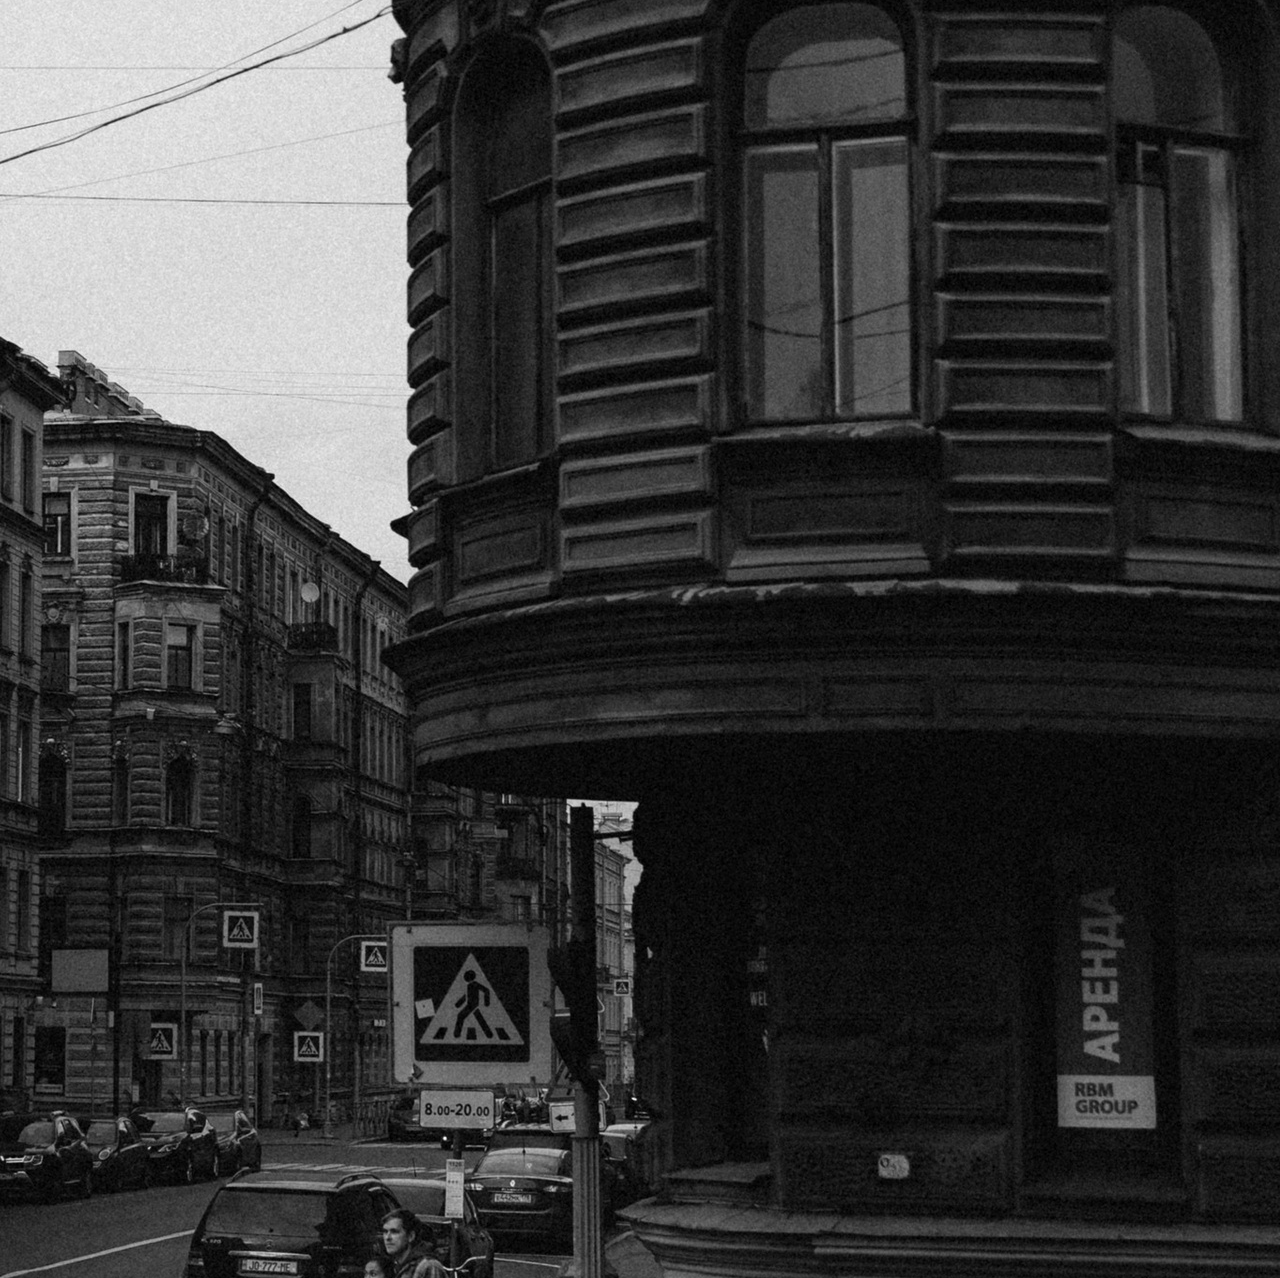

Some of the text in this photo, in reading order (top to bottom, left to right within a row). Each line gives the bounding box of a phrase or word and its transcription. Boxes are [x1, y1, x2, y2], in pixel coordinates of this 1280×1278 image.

[1080, 886, 1126, 1064] АРЕНДА
[1074, 1082, 1114, 1098] RBM
[424, 1102, 490, 1117] 8.00-20.00
[1075, 1099, 1139, 1115] GROUP
